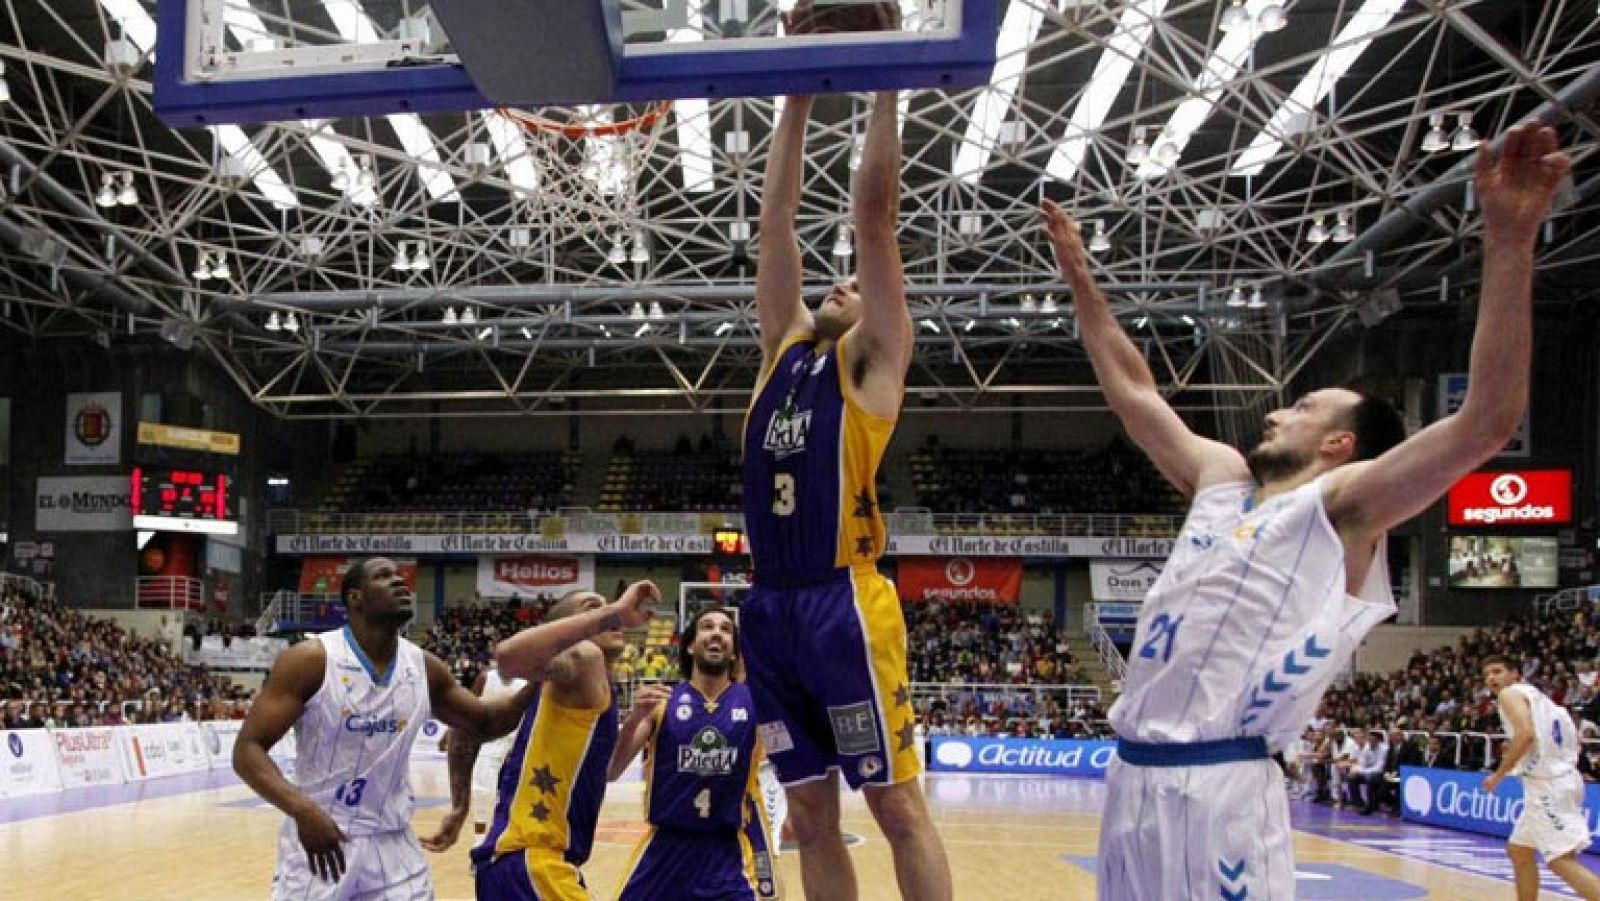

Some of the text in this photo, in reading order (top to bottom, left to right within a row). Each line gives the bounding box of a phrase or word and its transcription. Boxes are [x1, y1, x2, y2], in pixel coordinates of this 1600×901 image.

[772, 473, 796, 516] 3
[1463, 503, 1554, 523] segundos
[309, 535, 344, 551] Norte
[360, 535, 411, 551] Castilla
[460, 535, 497, 551] Norte
[619, 535, 656, 551] Norte
[928, 537, 1070, 553] El Norte de Castilla
[501, 563, 574, 580] Helios
[1107, 576, 1143, 588] Don
[1139, 612, 1184, 663] 21
[693, 788, 712, 818] 4
